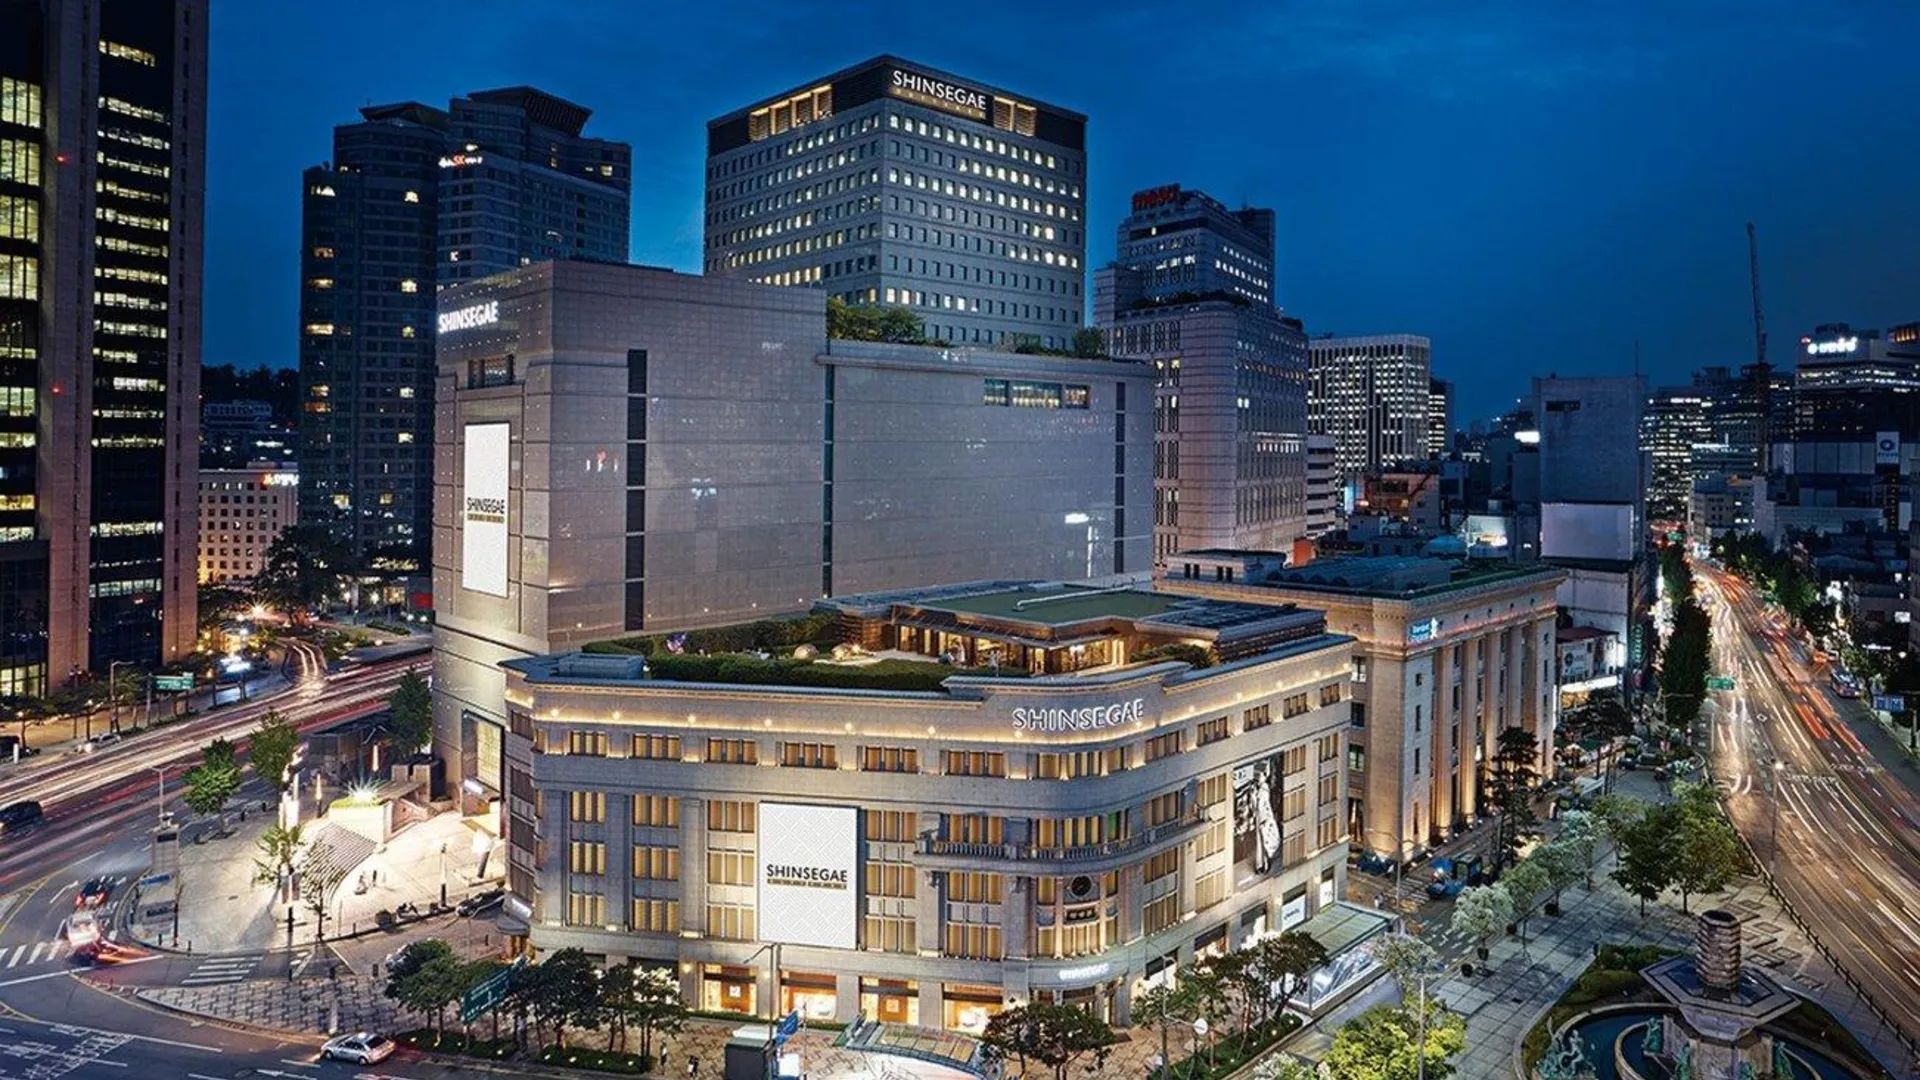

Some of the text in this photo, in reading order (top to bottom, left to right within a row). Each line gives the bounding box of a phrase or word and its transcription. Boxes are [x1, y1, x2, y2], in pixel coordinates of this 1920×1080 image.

[893, 70, 986, 110] SHINSEGAE
[439, 301, 498, 333] SHINSEGAE
[1012, 698, 1143, 731] SHINSEGAE
[767, 863, 847, 882] SHINSEGAE
